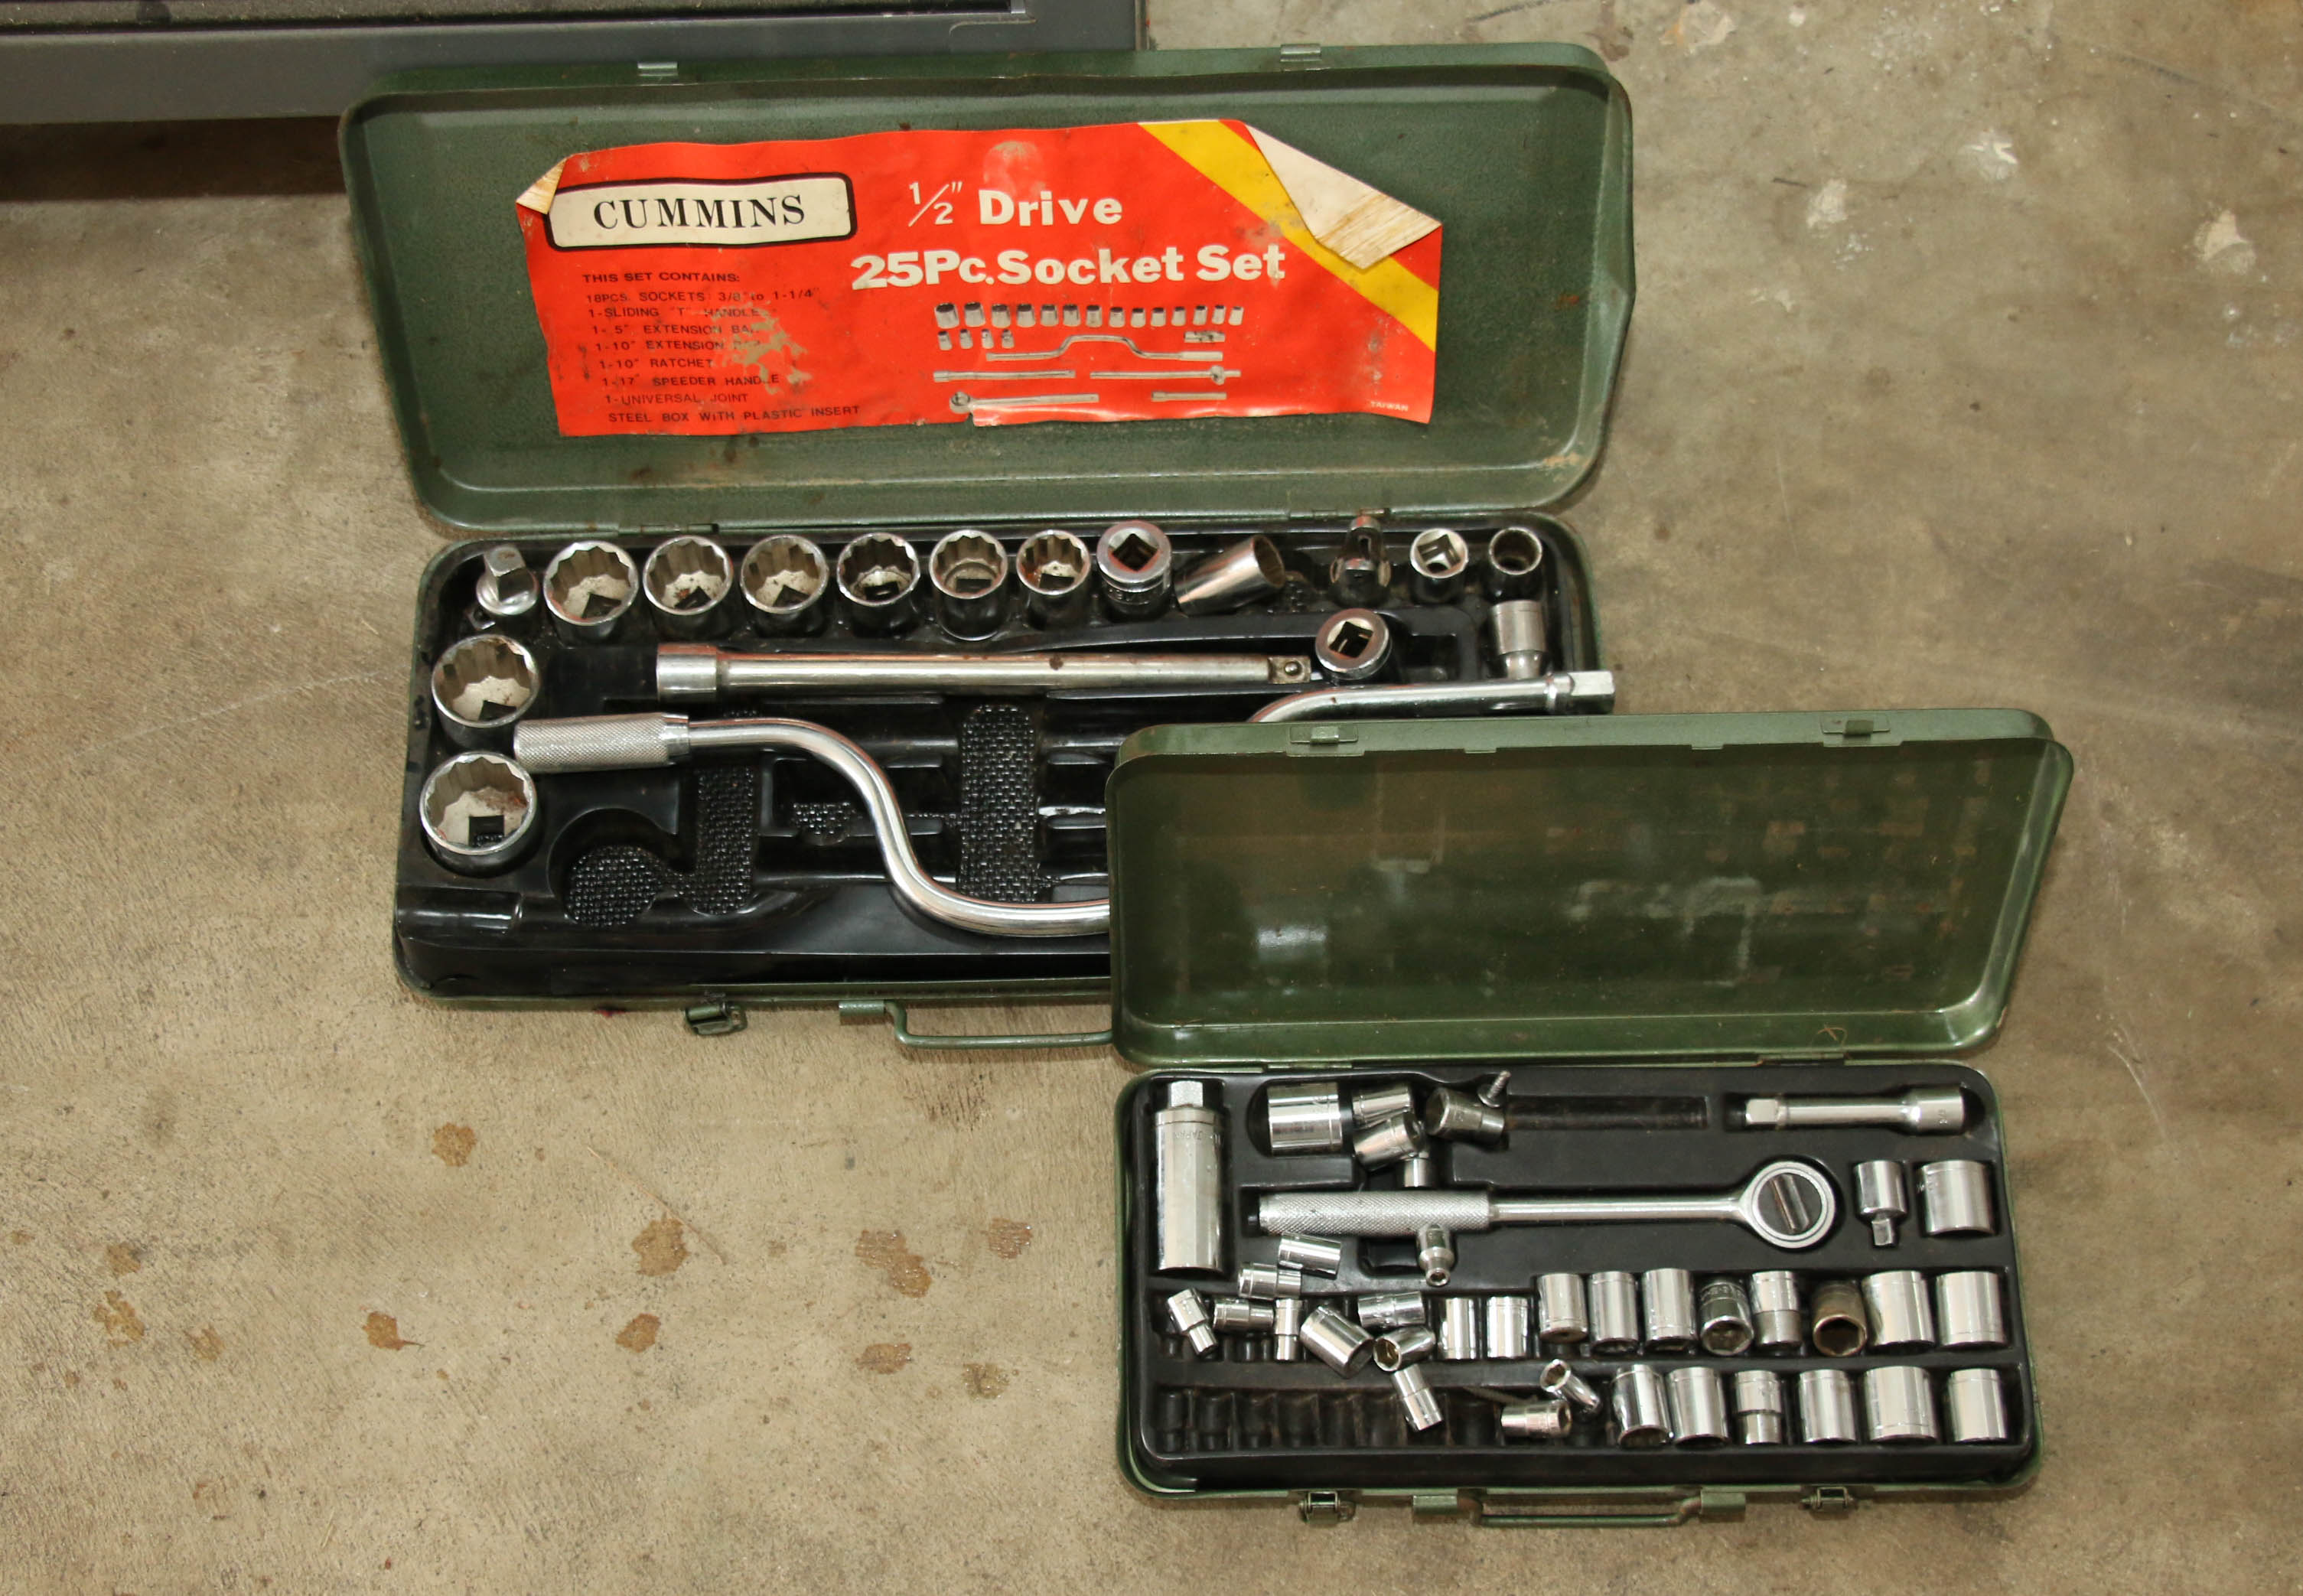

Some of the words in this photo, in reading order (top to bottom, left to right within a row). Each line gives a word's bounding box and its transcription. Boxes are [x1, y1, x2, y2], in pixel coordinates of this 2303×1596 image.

[593, 194, 805, 230] CUMMINS
[978, 189, 1123, 226] Drive
[1196, 243, 1286, 282] Set
[582, 273, 619, 283] THIS
[624, 272, 653, 282] SET
[659, 272, 741, 282] CONTAINS:
[751, 292, 764, 301] to
[703, 308, 760, 318] HANDLE
[643, 324, 722, 335] EXTENSION
[645, 340, 725, 350] EXTENSION
[599, 358, 640, 370] 1-10"
[650, 358, 713, 368] RATCHET
[652, 376, 717, 386] SPEEDER
[710, 392, 748, 403] JOINT
[608, 412, 653, 423] STEEL
[661, 412, 690, 422] BOX
[743, 408, 803, 421] PLASTIC
[811, 406, 861, 417] INSERT
